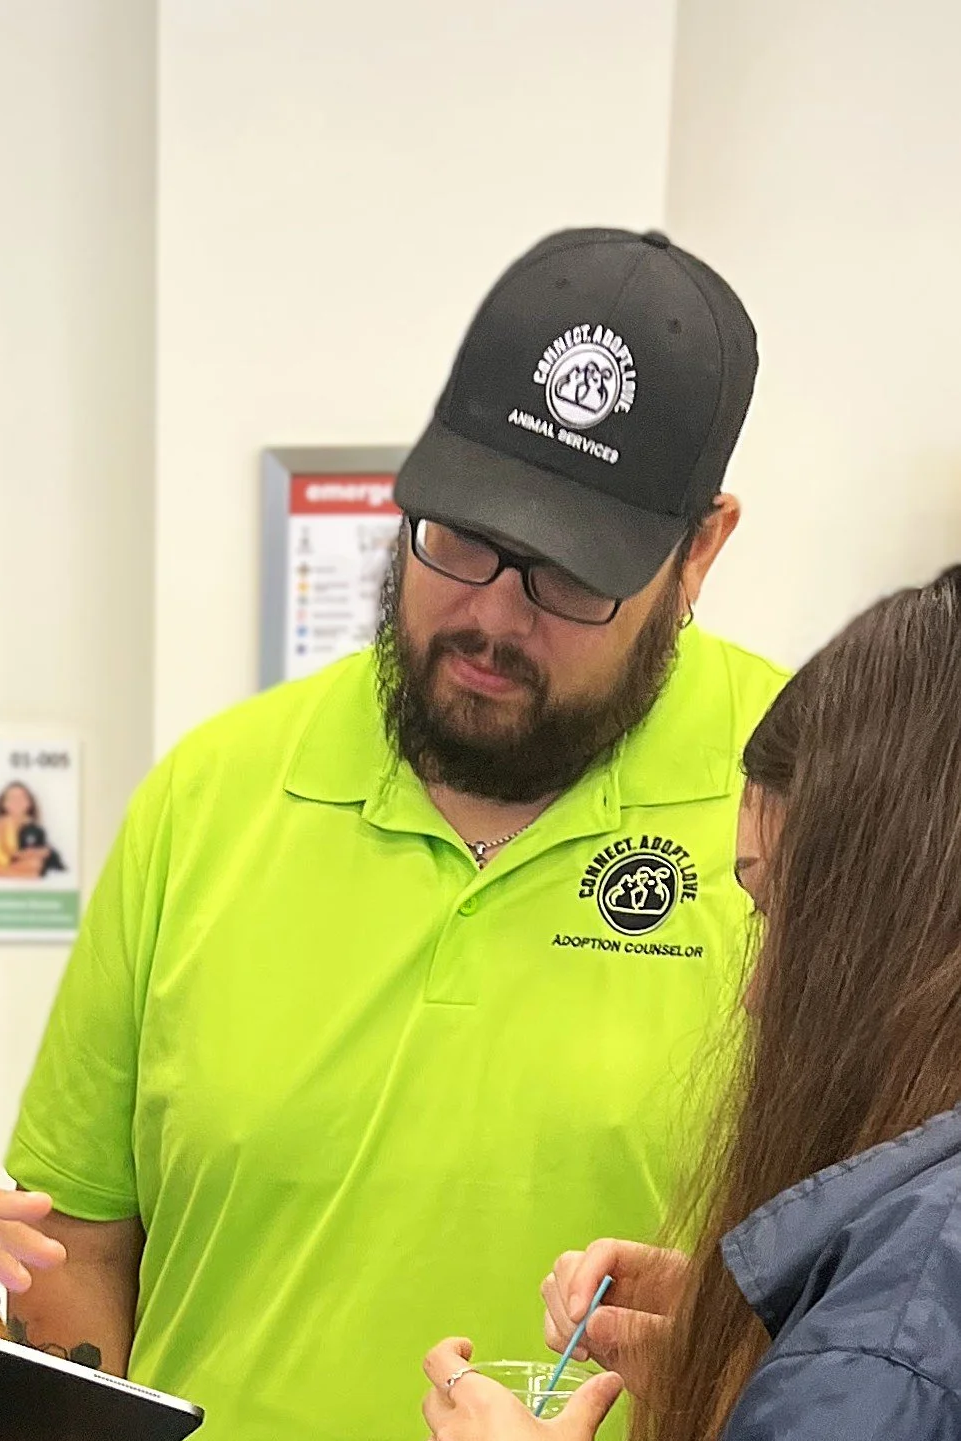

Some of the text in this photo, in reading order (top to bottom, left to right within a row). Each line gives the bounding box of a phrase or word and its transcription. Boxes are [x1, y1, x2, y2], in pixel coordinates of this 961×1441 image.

[507, 408, 619, 464] ANIMAL SERVICES
[552, 934, 704, 958] ADOPTION COUNSELOR
